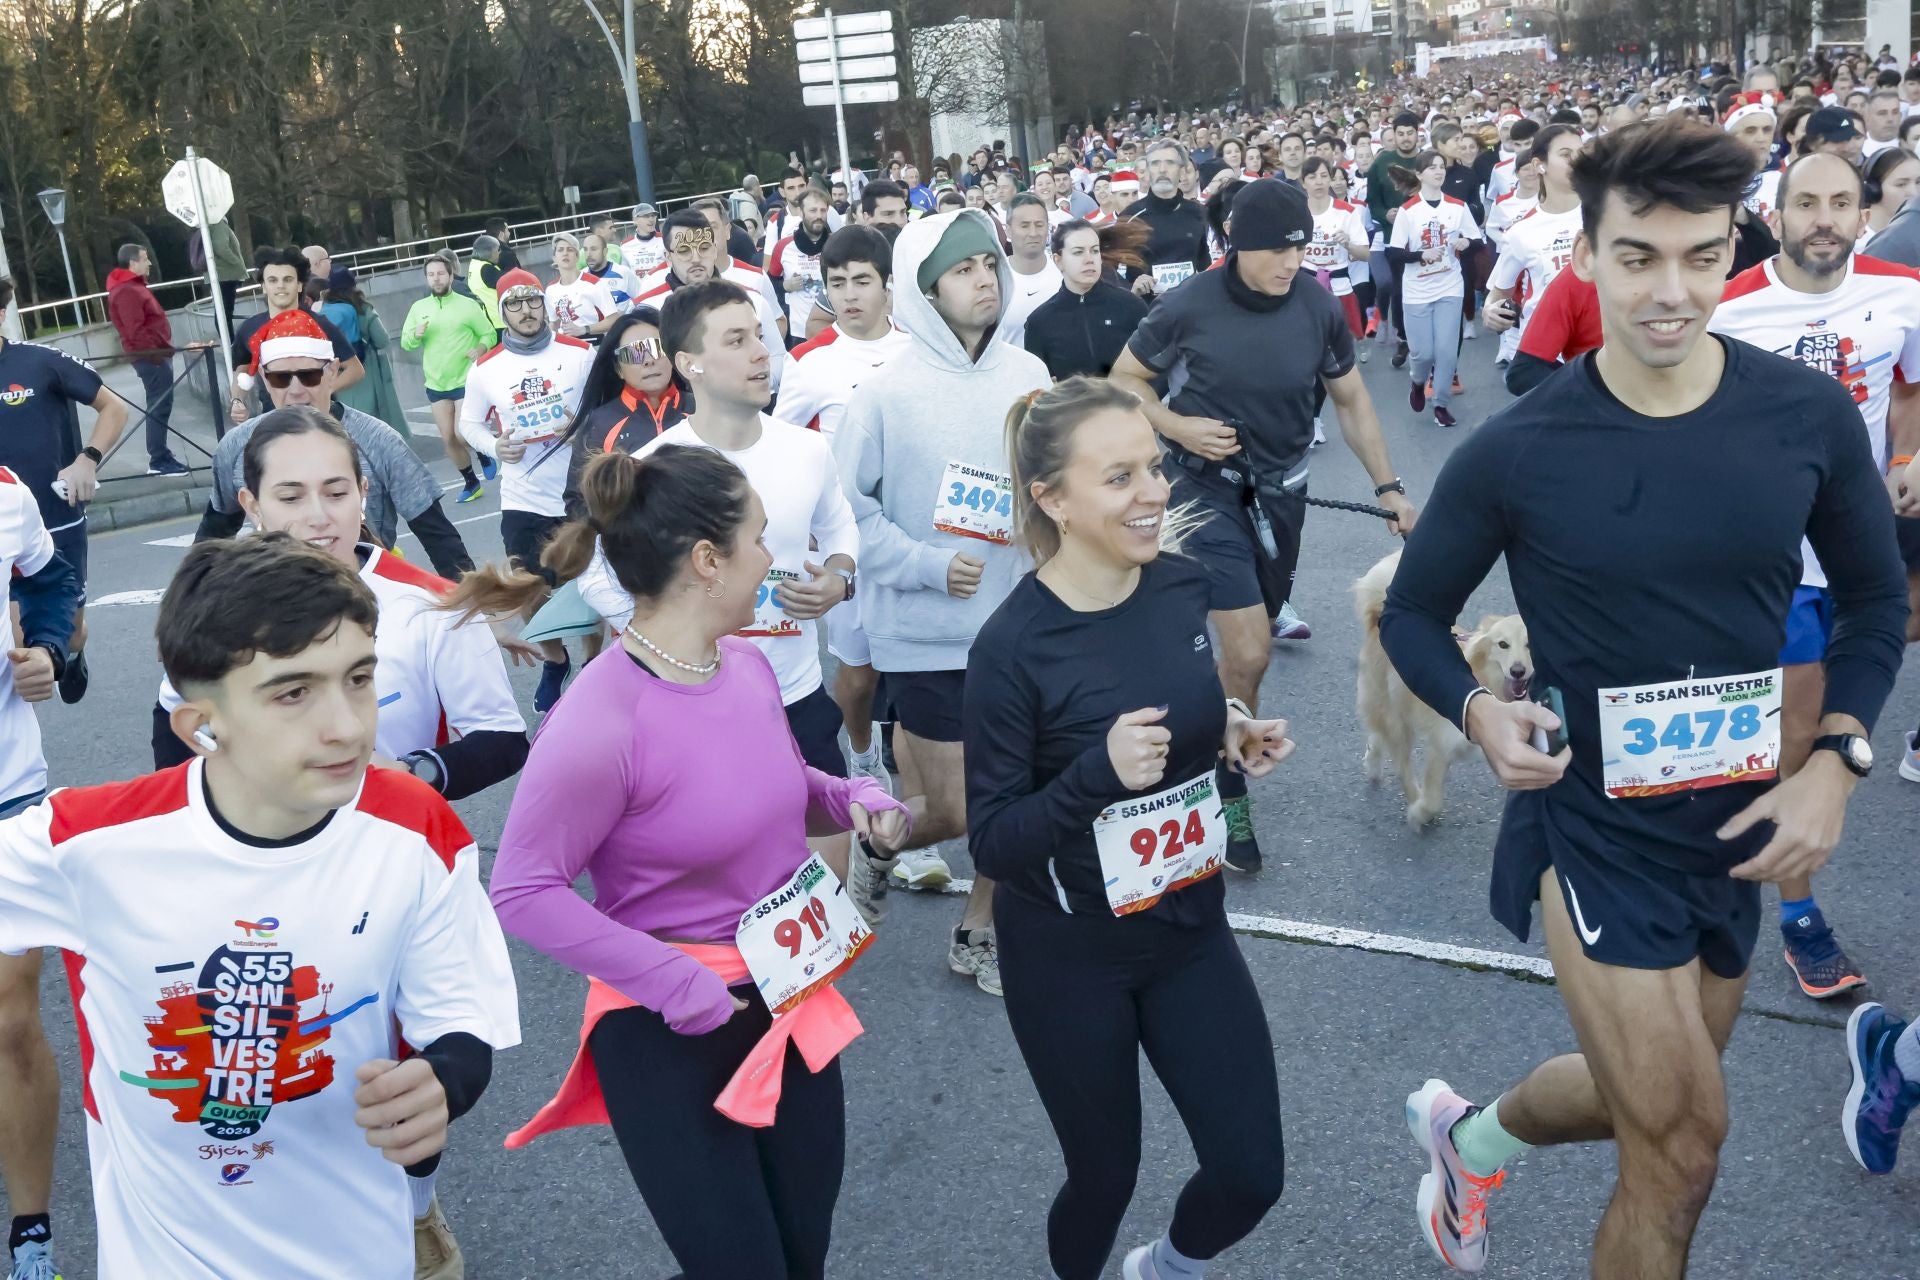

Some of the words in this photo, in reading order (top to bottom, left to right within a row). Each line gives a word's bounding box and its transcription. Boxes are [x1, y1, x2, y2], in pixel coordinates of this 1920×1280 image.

[675, 227, 712, 247] 2025
[1306, 247, 1334, 256] 2021
[1815, 334, 1838, 349] 55
[1802, 345, 1838, 362] SAN
[525, 384, 544, 394] SAN
[530, 377, 543, 385] 55
[517, 404, 564, 428] 3250
[961, 467, 971, 475] 55
[970, 469, 985, 479] SAN
[947, 481, 1012, 517] 3494
[769, 569, 799, 578] ESTRE
[1634, 691, 1655, 704] 55
[1657, 686, 1689, 702] SAN
[1691, 676, 1773, 697] SILVESTRE
[1750, 688, 1772, 699] 2024
[1622, 704, 1762, 755] 3478
[1672, 749, 1716, 761] FERNANDO
[1121, 806, 1139, 819] 55
[1140, 799, 1165, 814] SAN
[1166, 777, 1211, 807] SILVESTRE
[1130, 808, 1205, 868] 924
[1163, 857, 1187, 869] ANDREA
[755, 904, 772, 919] 55
[771, 889, 796, 910] SAN
[773, 895, 830, 959] 919
[232, 939, 278, 948] TotalEnergies
[242, 955, 291, 982] 55
[214, 971, 284, 1007] SAN
[212, 1005, 277, 1036] SIL
[211, 1037, 277, 1069] VES
[204, 1067, 276, 1106] TRE
[210, 1104, 262, 1121] GIJÓN
[217, 1127, 251, 1136] 2024
